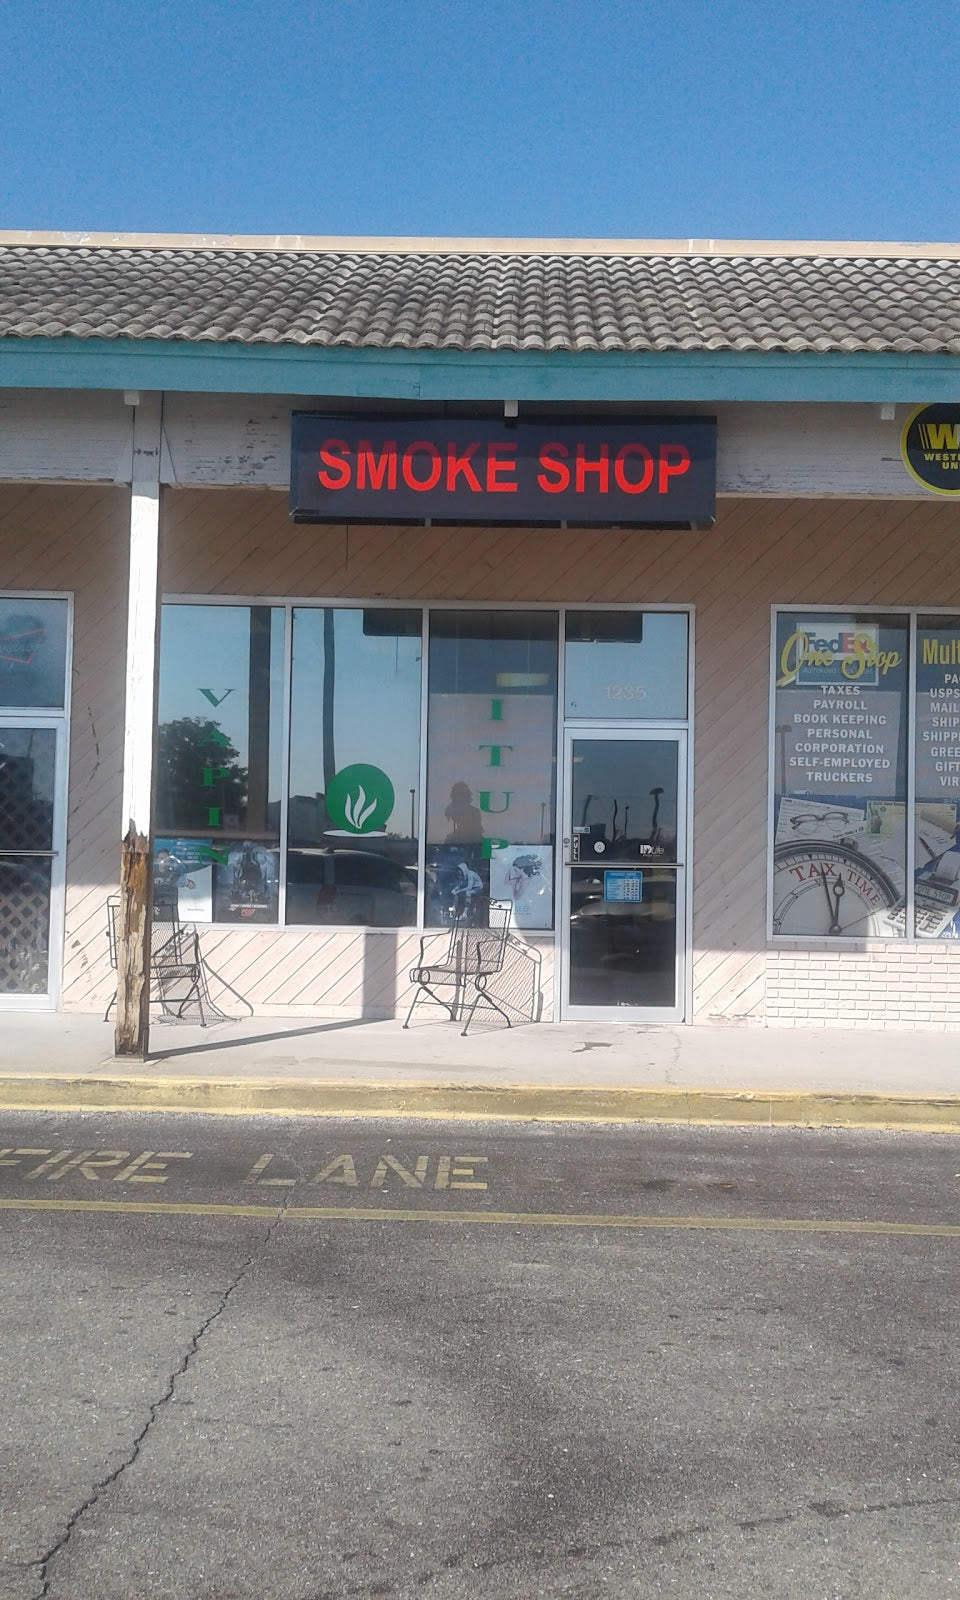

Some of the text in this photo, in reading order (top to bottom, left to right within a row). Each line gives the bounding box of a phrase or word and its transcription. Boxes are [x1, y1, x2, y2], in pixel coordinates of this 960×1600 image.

[318, 438, 692, 495] SMOKE SHOP
[804, 631, 871, 654] FedEx
[778, 630, 902, 684] One Stop
[944, 674, 960, 684] PA
[820, 685, 861, 696] TAXES
[930, 687, 960, 699] USPS
[813, 699, 868, 710] PAYROLL
[930, 702, 959, 713] MAIL
[793, 714, 887, 725] BOOK KEEPING
[807, 728, 873, 740] PERSONAL
[795, 743, 884, 754] CORPORATION
[789, 757, 891, 769] SELF-EMPLOYED
[935, 761, 960, 772] GIFT
[806, 771, 873, 783] TRUCKERS
[940, 775, 960, 786] VIR
[789, 863, 880, 906] TAX TIME
[0, 1148, 489, 1190] FIRE LANE
